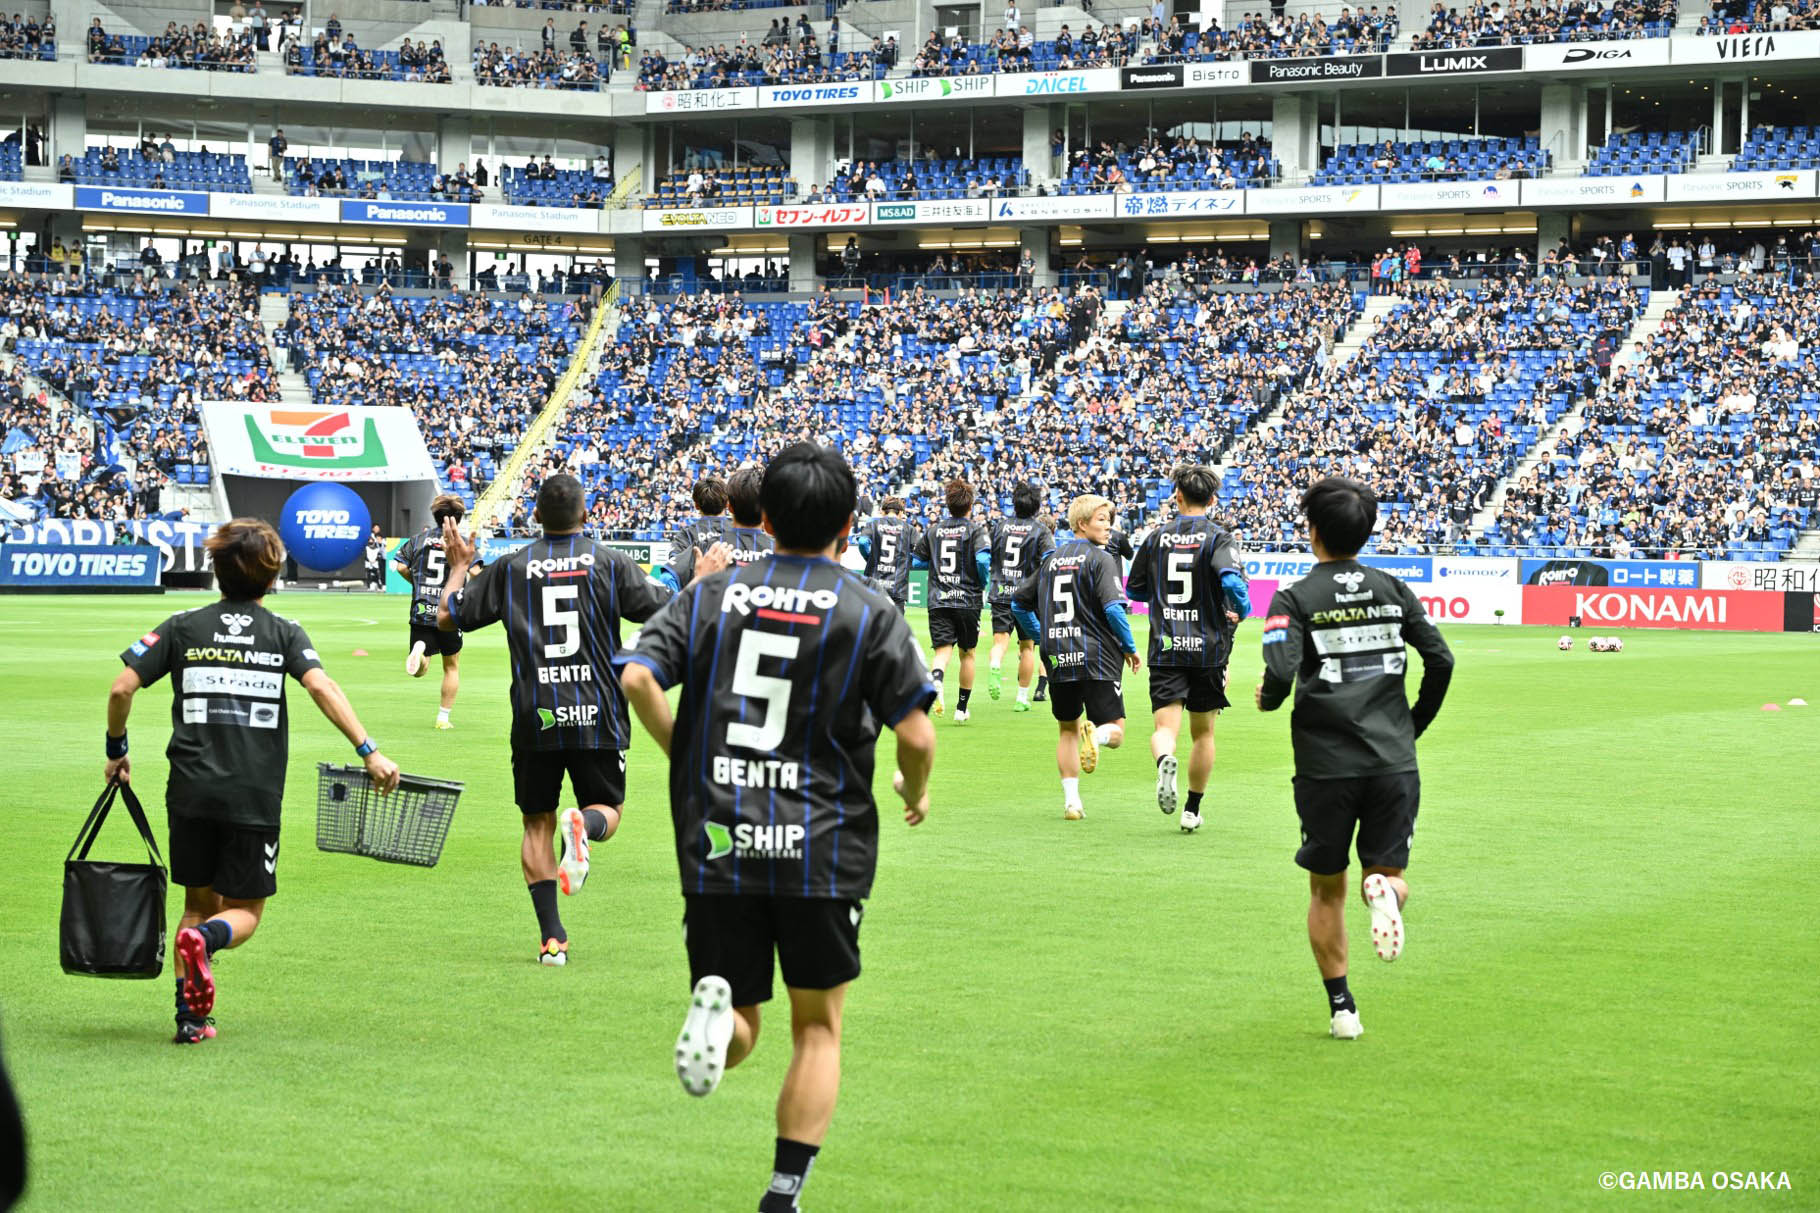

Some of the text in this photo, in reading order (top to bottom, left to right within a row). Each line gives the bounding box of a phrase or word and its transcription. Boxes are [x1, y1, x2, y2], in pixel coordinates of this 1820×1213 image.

[1420, 55, 1488, 72] LUMIX
[1562, 49, 1632, 64] DIGA
[1192, 70, 1239, 81] Bistro
[1269, 62, 1363, 78] Panasonic Beauty
[954, 77, 989, 91] SHIP
[1026, 76, 1087, 94] DAICEL
[1130, 72, 1176, 84] Panasonic
[772, 87, 859, 102] TOYO TIRES
[895, 80, 930, 94] SHIP
[677, 91, 742, 109] 昭和化工
[10, 184, 51, 197] Stadium
[1579, 185, 1615, 195] SPORTS
[1726, 180, 1763, 191] SPORTS
[101, 191, 185, 210] Panasonic
[1299, 194, 1332, 204] SPORTS
[1437, 190, 1471, 200] SPORTS
[229, 197, 320, 210] Panasonic Stadium
[366, 205, 447, 222] Panasonic
[492, 208, 578, 221] Panasonic Stadium
[879, 207, 914, 218] MS&AD
[921, 205, 984, 218] 三井住友海上
[523, 233, 562, 244] GATE 4
[296, 511, 350, 525] TOYO
[304, 525, 361, 540] TIRES
[877, 523, 904, 532] ROHTO
[936, 525, 967, 538] ROHTO
[1003, 524, 1033, 533] ROHTO
[1159, 532, 1207, 548] ROHTO
[879, 534, 897, 564] 5
[940, 539, 958, 574] 5
[1003, 535, 1023, 568] 5
[10, 552, 147, 577] TOYO TIRES
[425, 549, 447, 586] 5
[526, 553, 596, 579] ROHTO
[1048, 554, 1087, 572] ROHTO
[1264, 562, 1312, 576] TIRE
[1167, 552, 1194, 604] 5
[1538, 567, 1579, 586] ROHTO
[1613, 568, 1695, 585] ロート製薬
[420, 586, 443, 596] GENT
[1052, 574, 1075, 623] 5
[721, 583, 838, 616] ROHTO
[1163, 607, 1199, 621] GENTA
[1419, 596, 1470, 619] mo
[1575, 592, 1727, 623] KONAMI
[541, 584, 581, 659] 5
[213, 632, 255, 645] hummel
[1048, 626, 1082, 639] GENTA
[1172, 636, 1203, 648] SHIP
[1058, 651, 1085, 664] SHIP
[538, 664, 592, 684] GENTA
[205, 674, 278, 690] Strada
[726, 628, 800, 751] 5
[556, 704, 599, 722] SHIP
[713, 756, 799, 790] GENTA
[735, 823, 806, 850] SHIP
